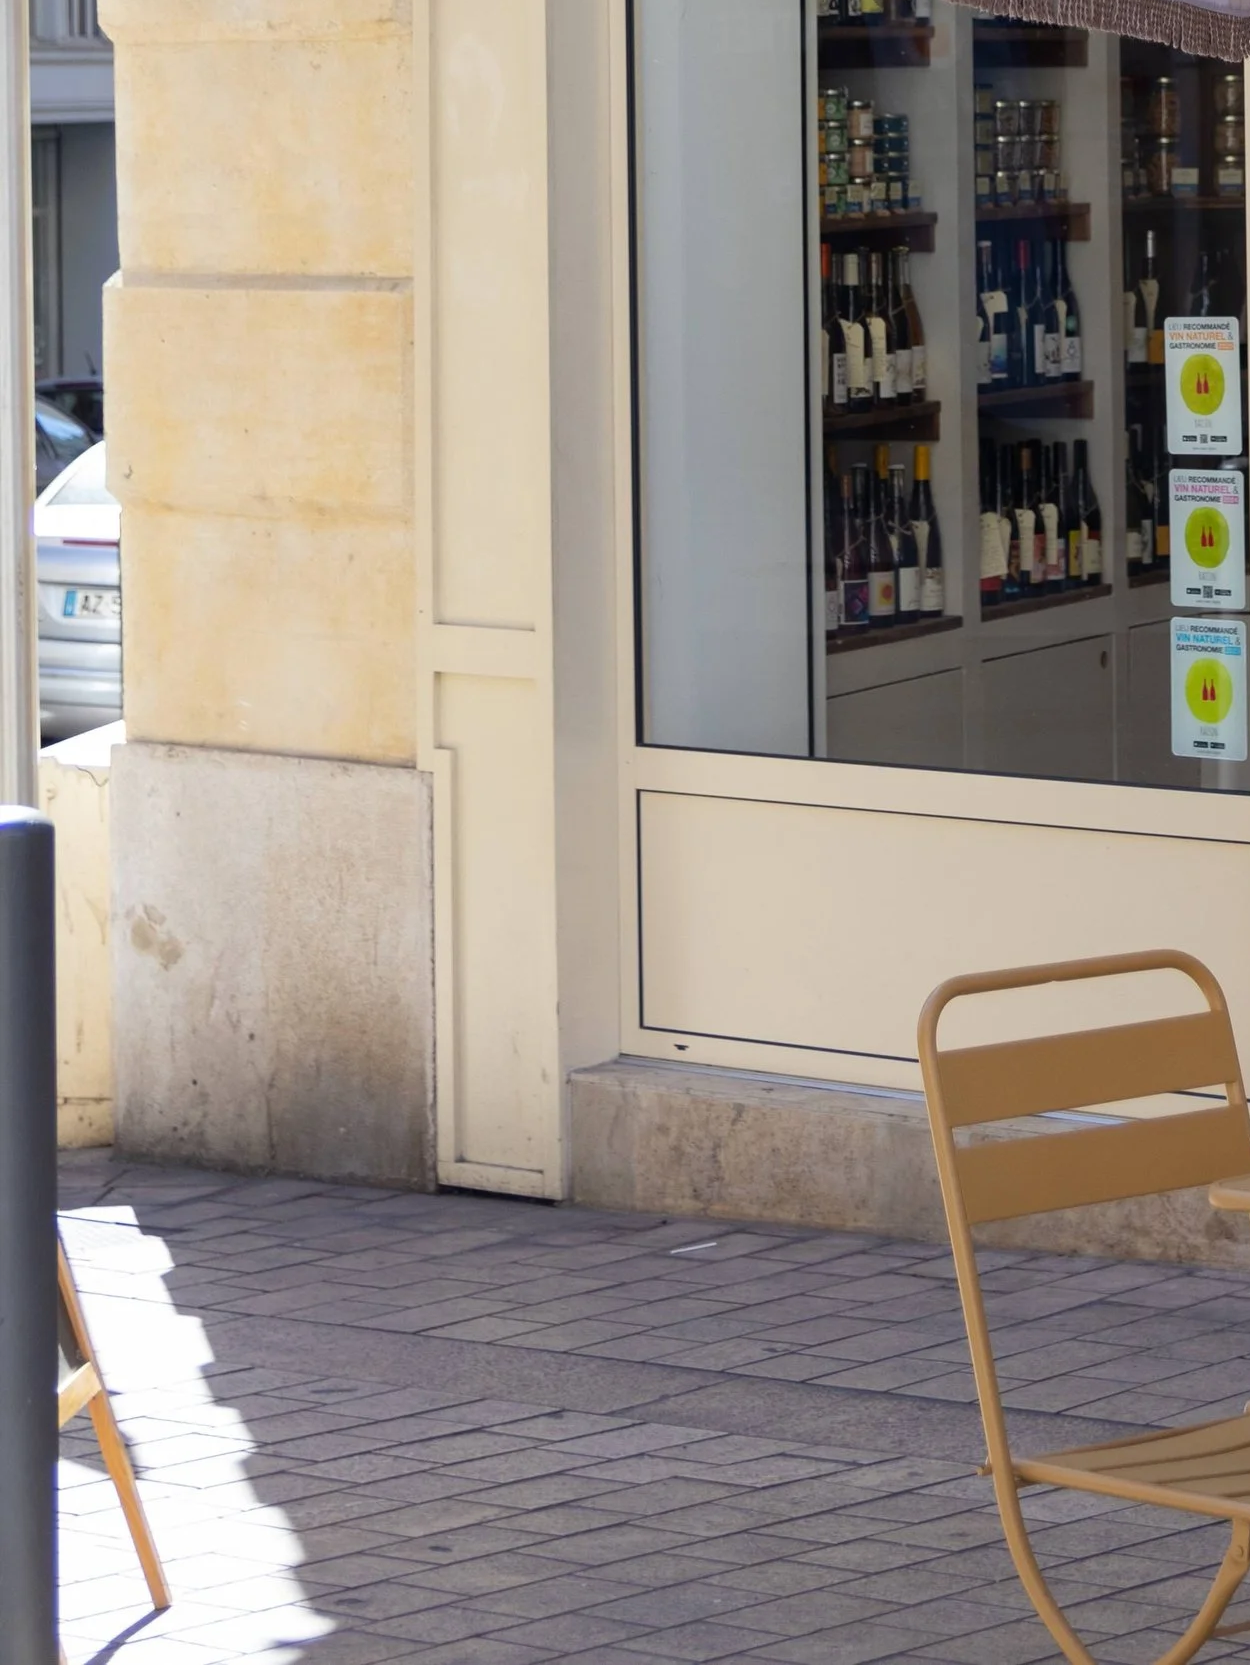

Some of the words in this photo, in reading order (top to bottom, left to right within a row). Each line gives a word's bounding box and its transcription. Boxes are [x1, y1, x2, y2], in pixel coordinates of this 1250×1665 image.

[1169, 331, 1184, 341] VIN
[1186, 331, 1225, 341] NATUREL
[1169, 342, 1217, 350] GASTRONOMIE
[1174, 484, 1189, 493] VIN
[1191, 484, 1231, 494] NATUREL
[1174, 494, 1221, 503] GASTRONOMIE
[1176, 633, 1191, 642] VIN
[1193, 634, 1233, 645] NATUREL
[1176, 644, 1223, 654] GASTRONOMIE
